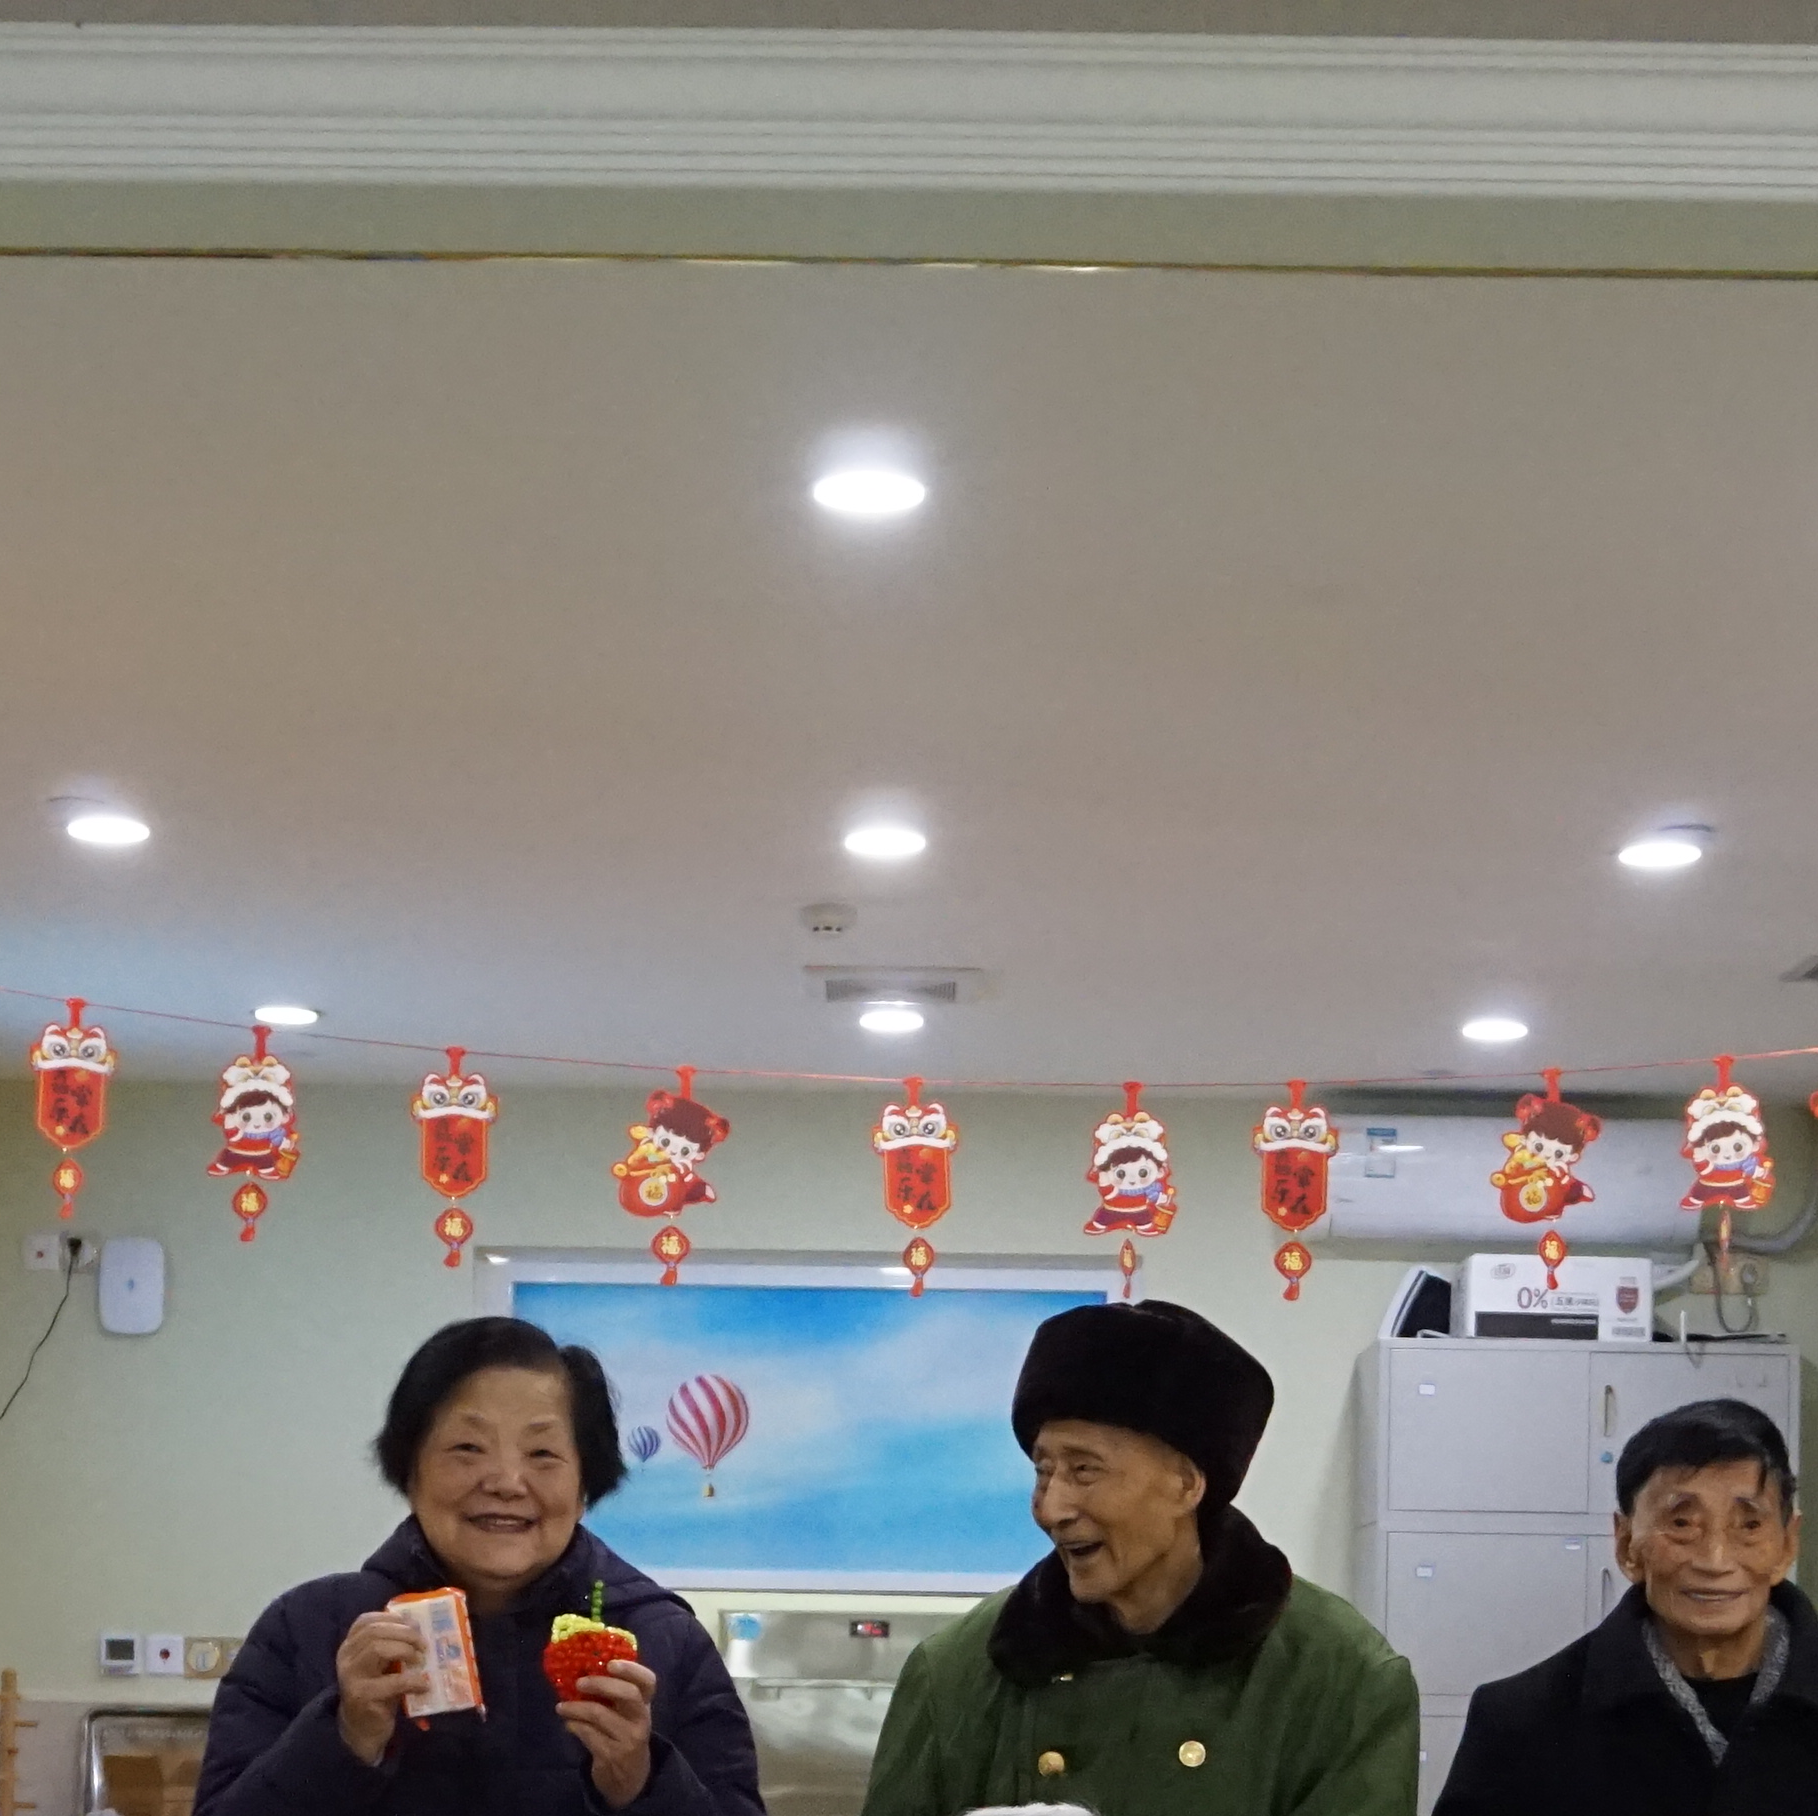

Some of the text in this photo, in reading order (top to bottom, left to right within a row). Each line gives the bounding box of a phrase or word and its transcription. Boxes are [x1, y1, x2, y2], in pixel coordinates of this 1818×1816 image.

[240, 1192, 259, 1212] 福
[445, 1217, 463, 1237] 福
[661, 1235, 681, 1255] 福
[1545, 1240, 1560, 1260] 福
[911, 1246, 928, 1266] 福
[1284, 1251, 1303, 1271] 福
[1517, 1286, 1549, 1309] 0%
